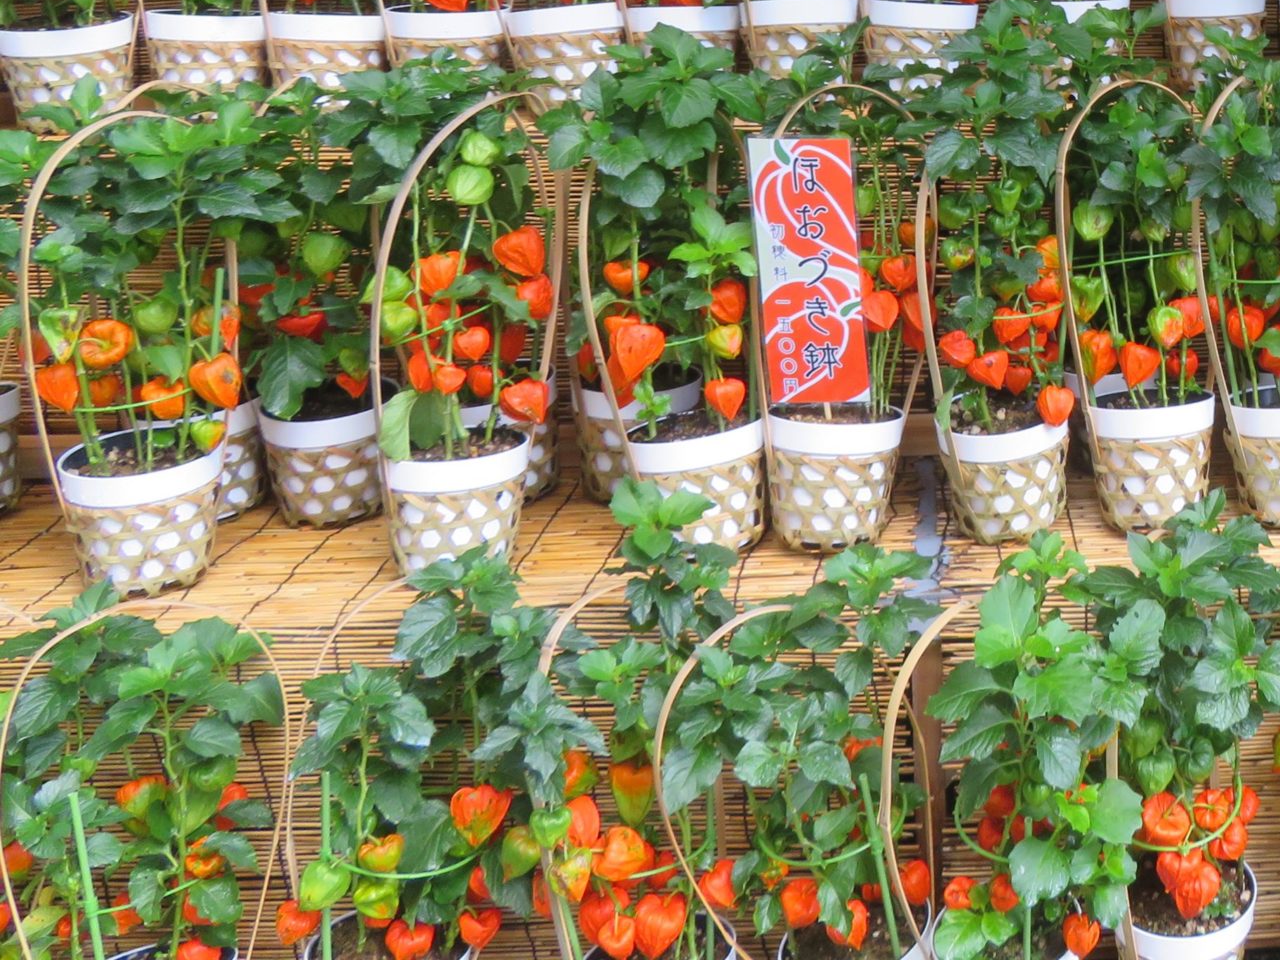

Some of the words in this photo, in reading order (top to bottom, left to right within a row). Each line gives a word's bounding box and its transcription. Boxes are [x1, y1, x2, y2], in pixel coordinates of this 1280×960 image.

[792, 156, 841, 379] ほおづき鉢
